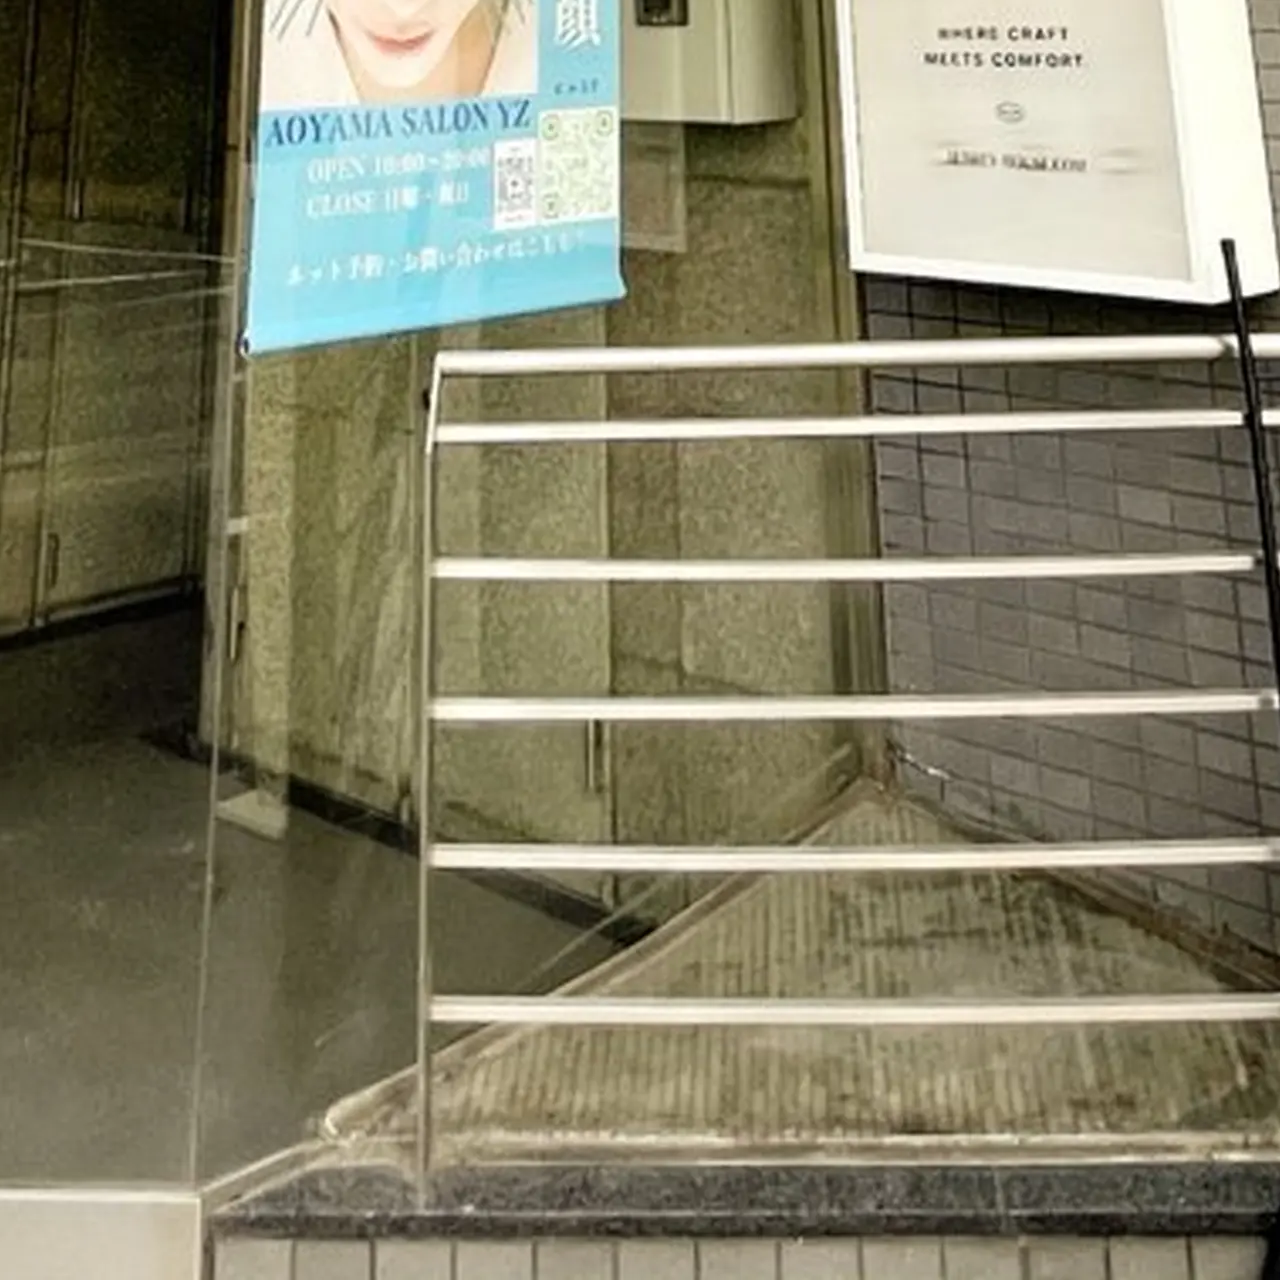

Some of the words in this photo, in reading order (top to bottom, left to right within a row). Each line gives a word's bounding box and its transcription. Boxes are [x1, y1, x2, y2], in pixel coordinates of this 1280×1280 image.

[1007, 26, 1068, 41] CRAFT
[924, 52, 984, 67] MEETS
[990, 52, 1083, 68] COMFORT
[264, 111, 393, 148] AOYAMA
[400, 101, 489, 139] SALON
[496, 98, 531, 133] YZ
[307, 156, 365, 183] OPEN
